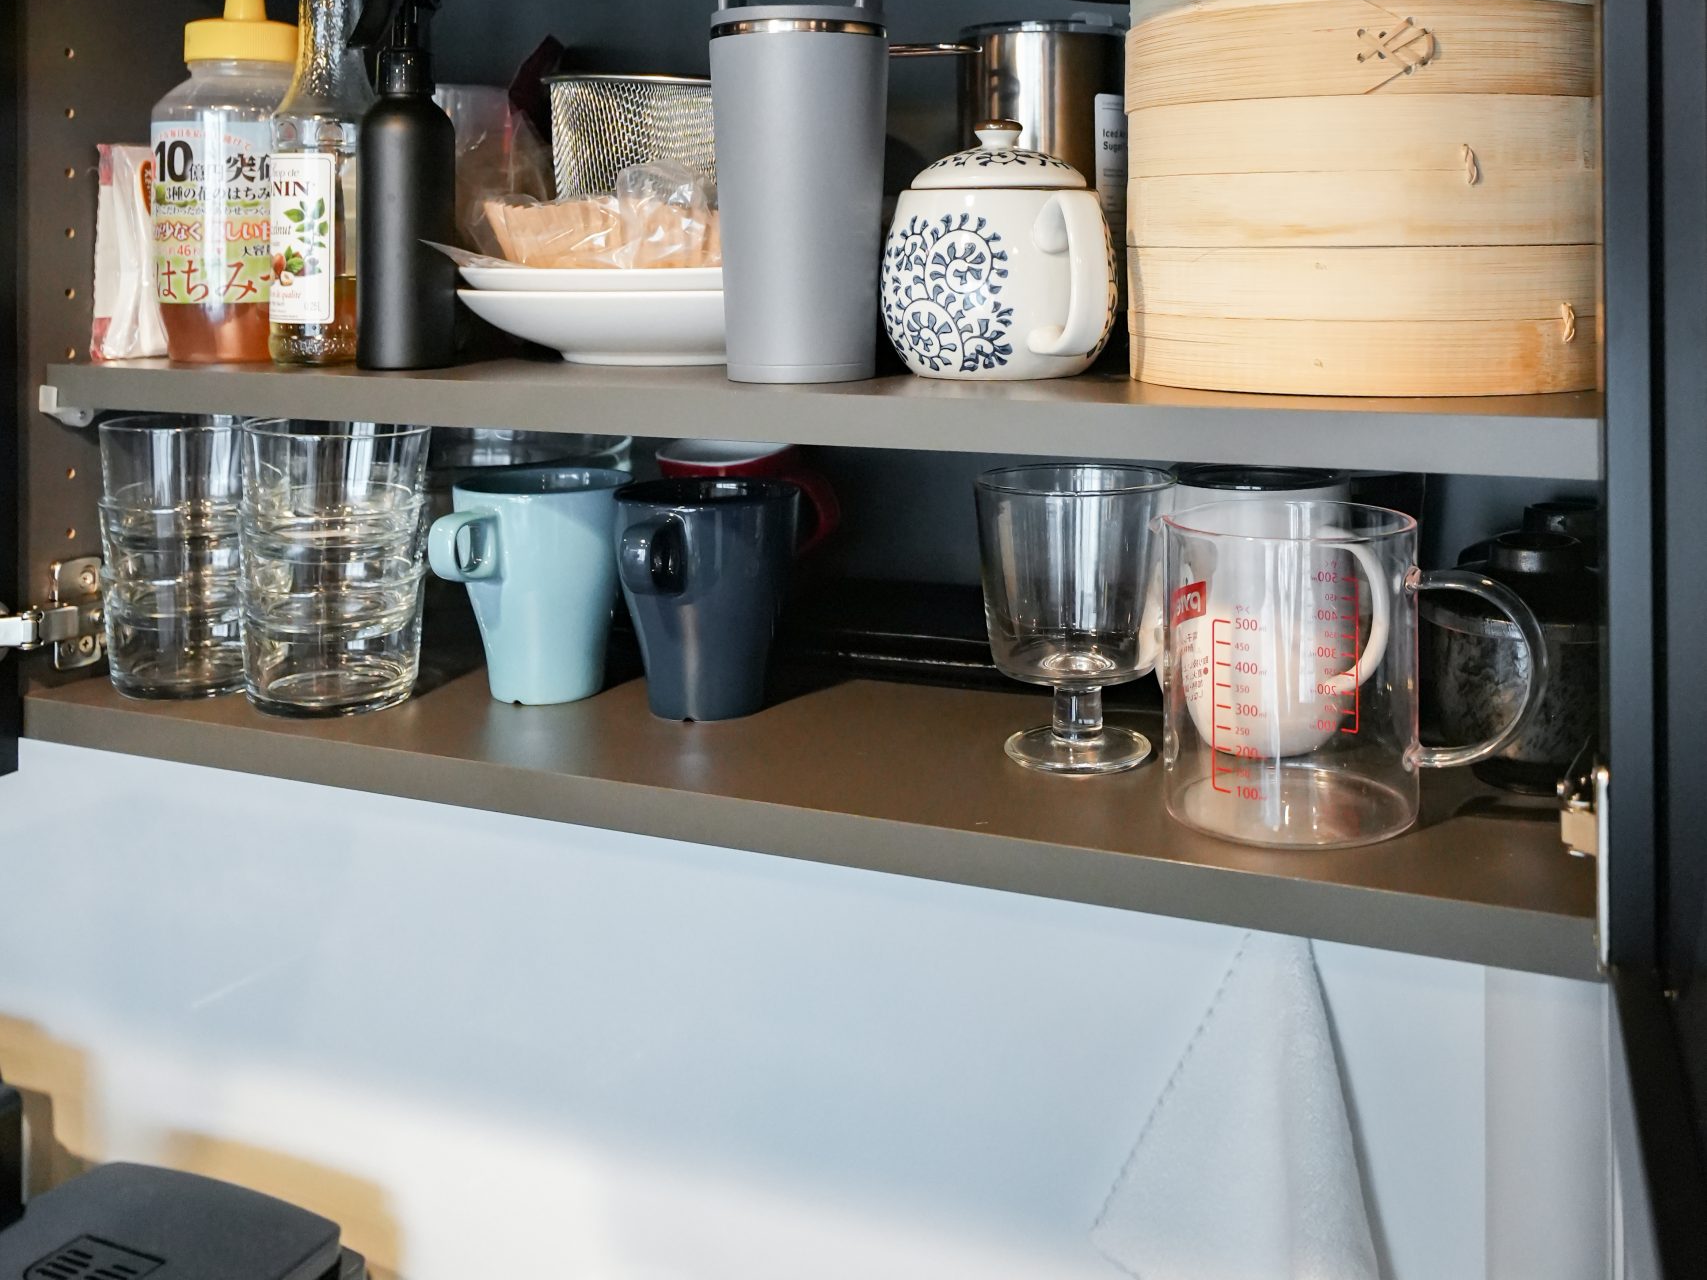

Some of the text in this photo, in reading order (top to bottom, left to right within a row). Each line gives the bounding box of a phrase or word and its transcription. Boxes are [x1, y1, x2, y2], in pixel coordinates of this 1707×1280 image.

[271, 181, 309, 196] NIN
[1235, 643, 1249, 651] 450
[1235, 685, 1250, 694] 350
[1235, 727, 1250, 736] 250
